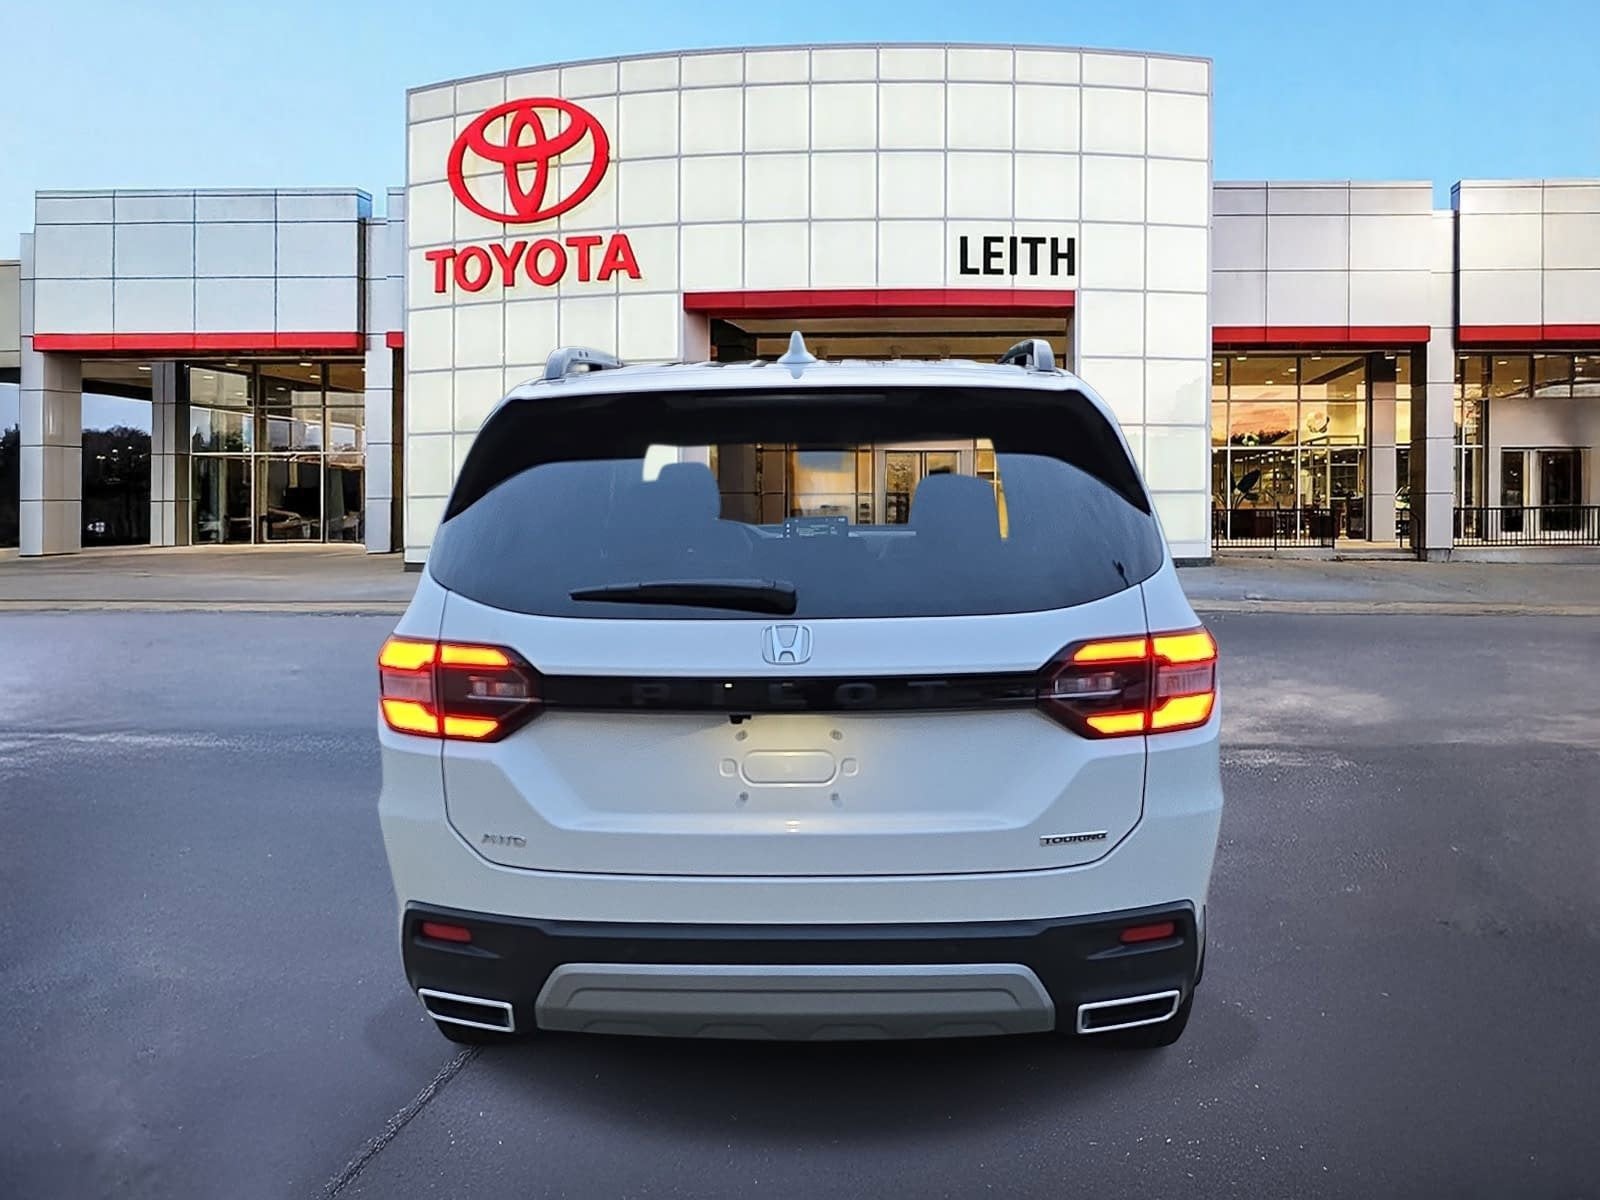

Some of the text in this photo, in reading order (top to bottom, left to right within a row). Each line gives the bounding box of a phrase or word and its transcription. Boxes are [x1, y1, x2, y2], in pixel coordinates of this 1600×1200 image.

[426, 234, 640, 293] TOYOTA
[959, 236, 1076, 276] LEITH
[1041, 831, 1107, 846] TOURING
